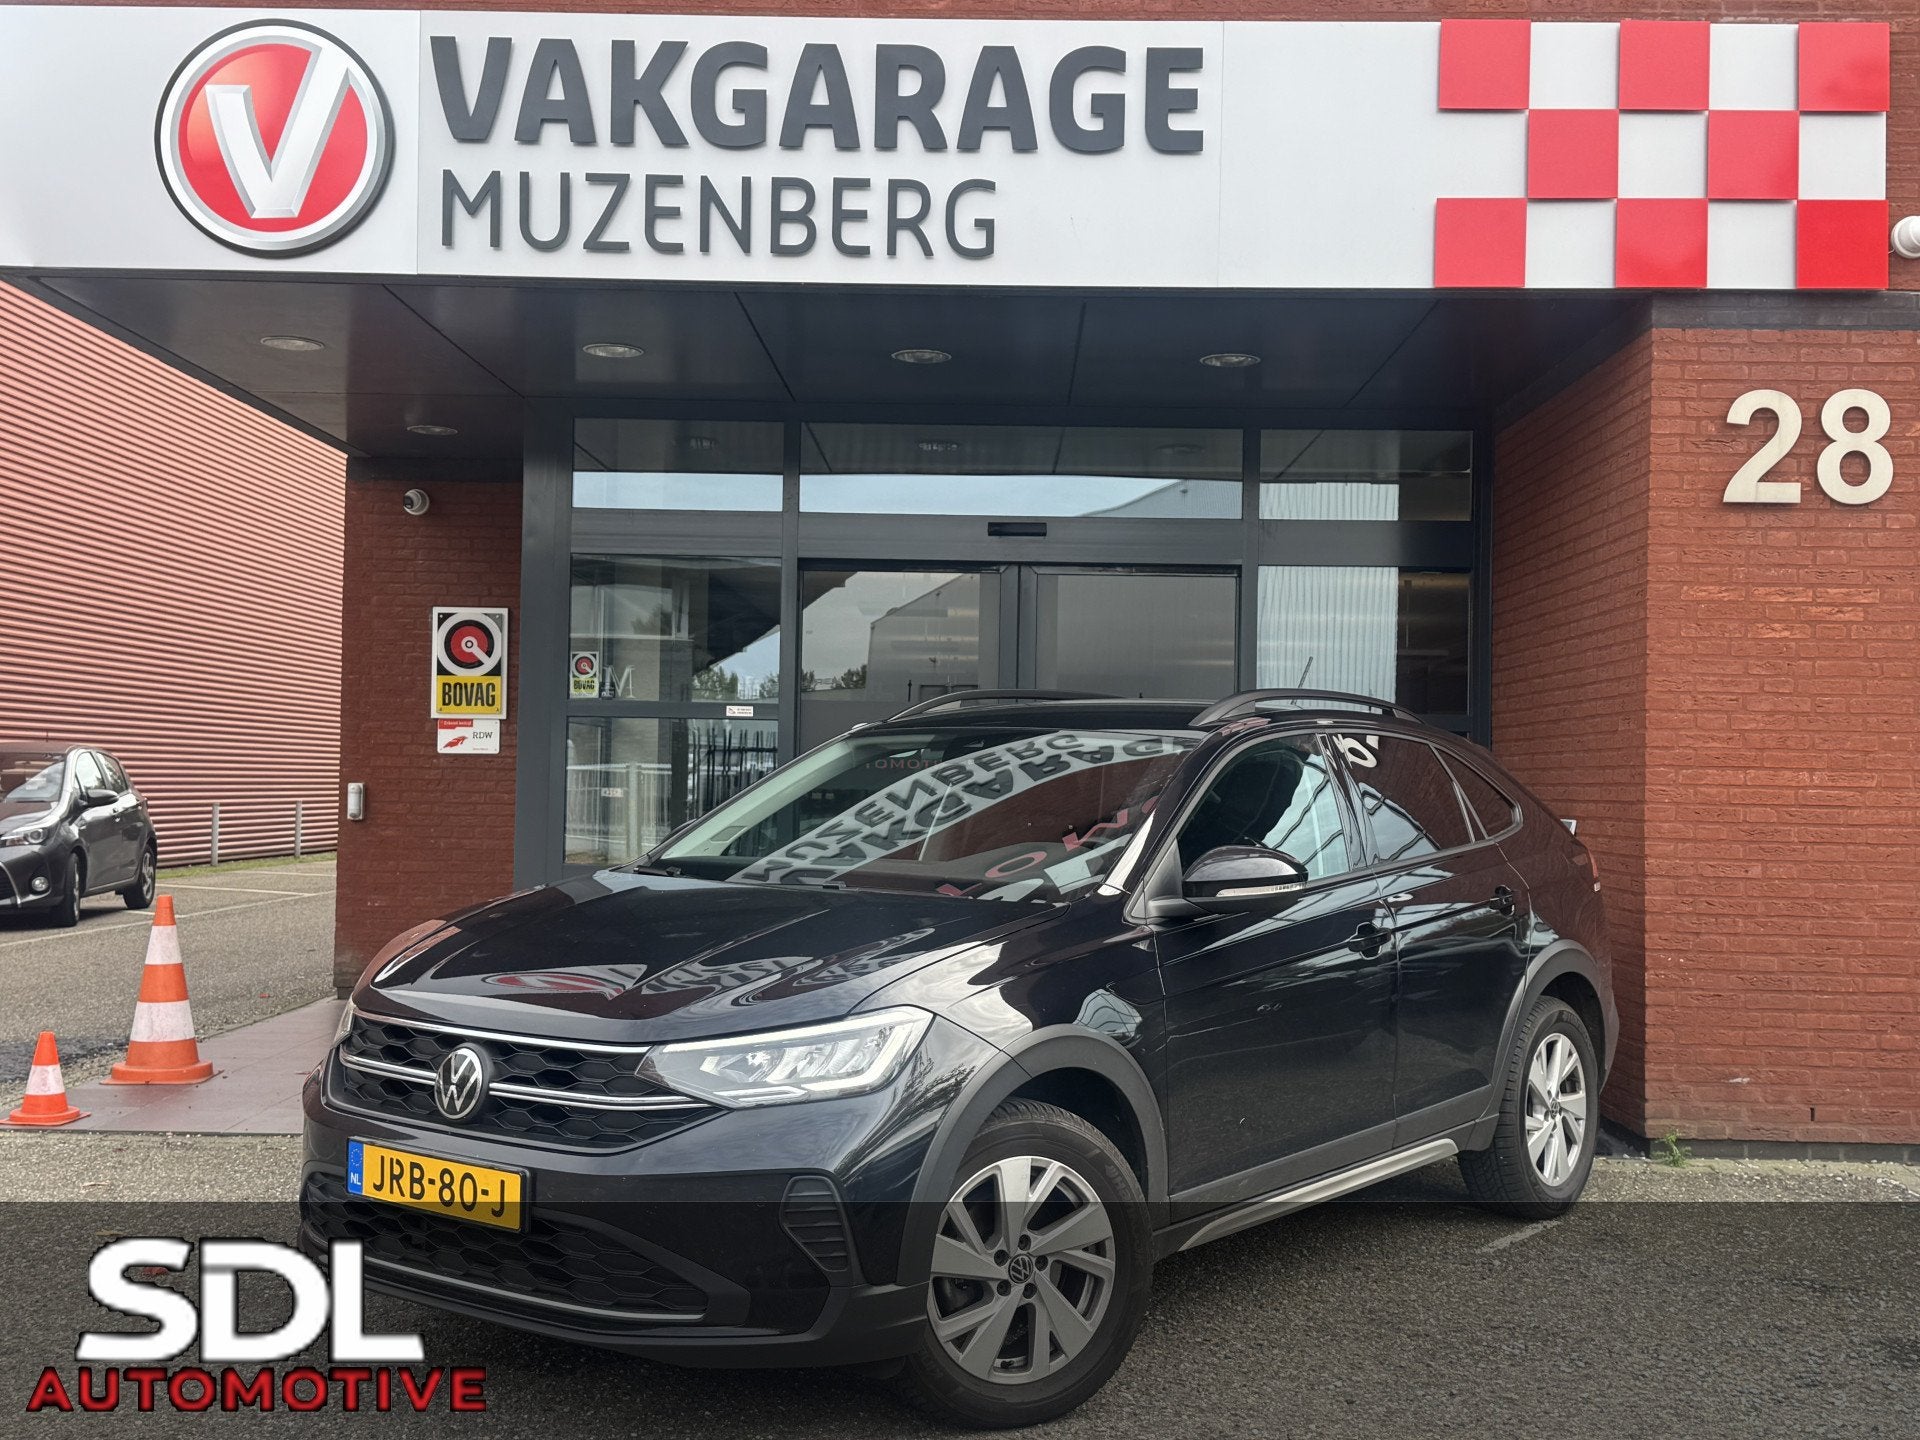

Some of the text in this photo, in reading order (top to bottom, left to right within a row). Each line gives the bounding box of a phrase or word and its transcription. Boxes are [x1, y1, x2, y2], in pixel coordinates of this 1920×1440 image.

[429, 35, 1204, 155] VAKGARAGE
[441, 168, 996, 260] MUZENBERG
[1722, 388, 1895, 505] 28
[441, 682, 496, 707] BOVAG
[573, 679, 595, 690] BOVAG
[472, 731, 493, 739] RDW
[350, 1172, 362, 1186] NL
[372, 1154, 506, 1218] JRB-80-J
